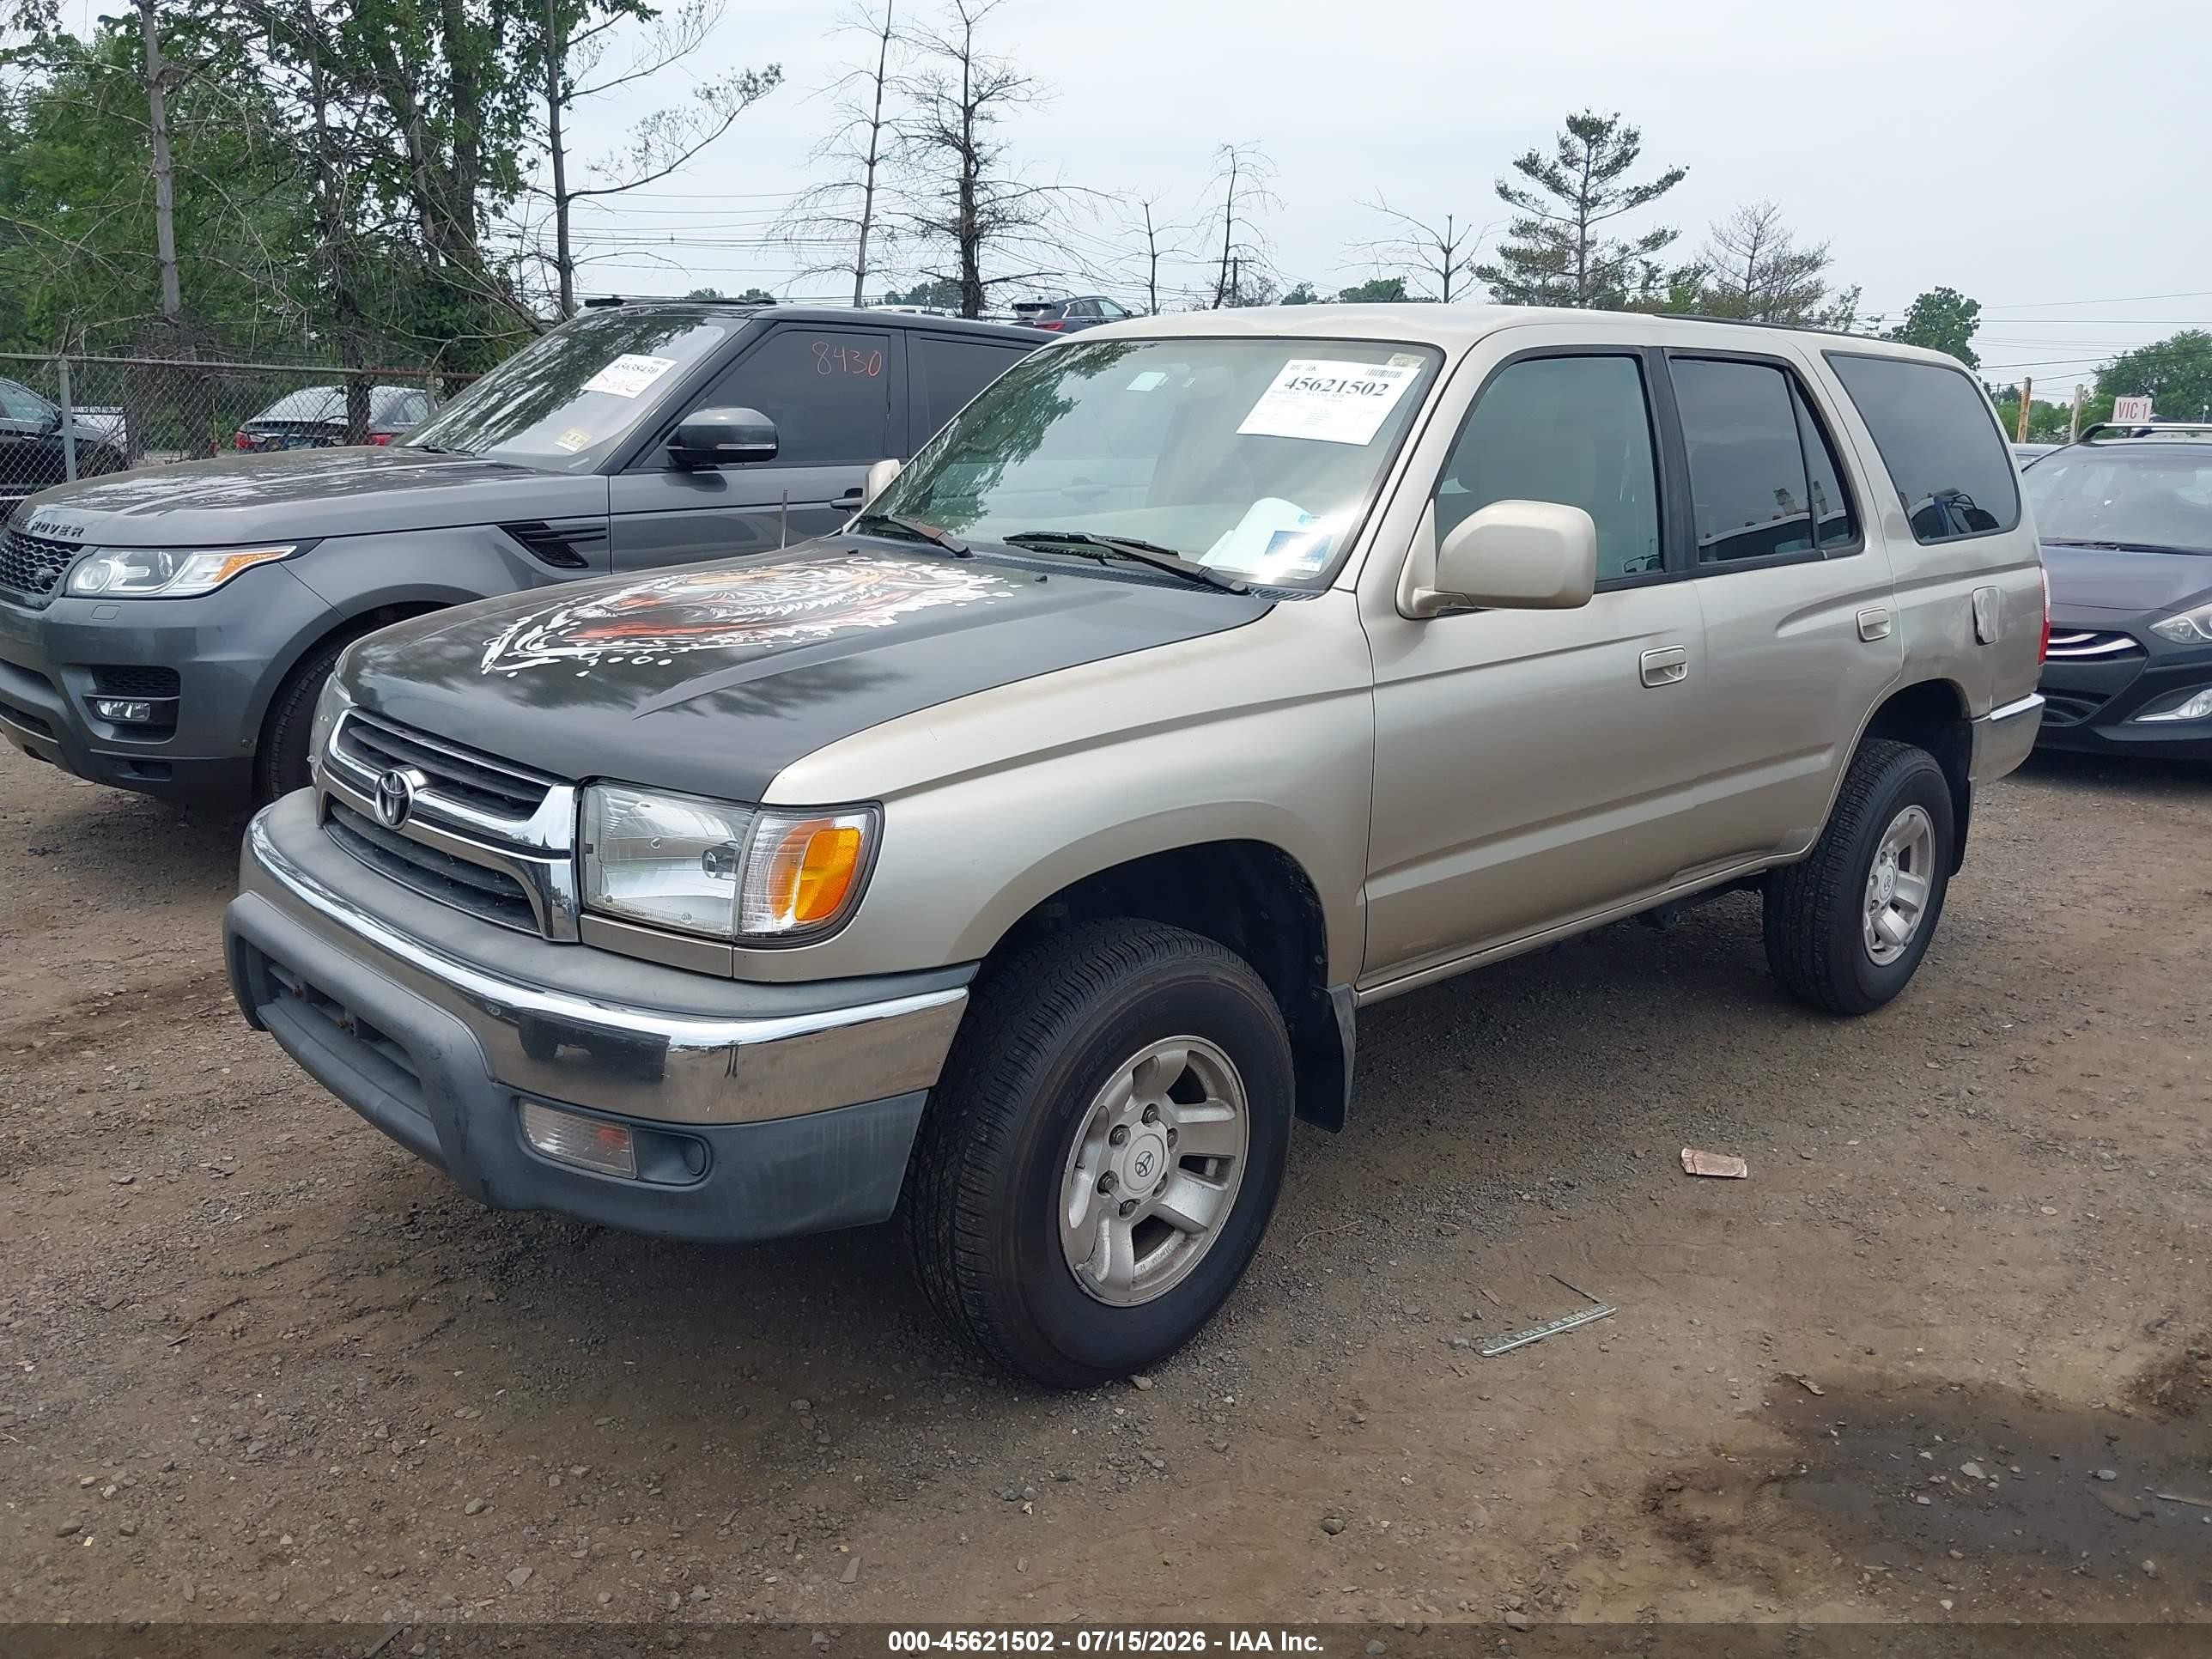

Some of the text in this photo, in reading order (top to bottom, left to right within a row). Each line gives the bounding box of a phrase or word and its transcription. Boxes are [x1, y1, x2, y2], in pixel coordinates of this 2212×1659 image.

[811, 340, 883, 377] 8430
[1285, 376, 1389, 397] 45621502
[2118, 401, 2148, 420] VIC 1
[31, 520, 84, 538] ROVER
